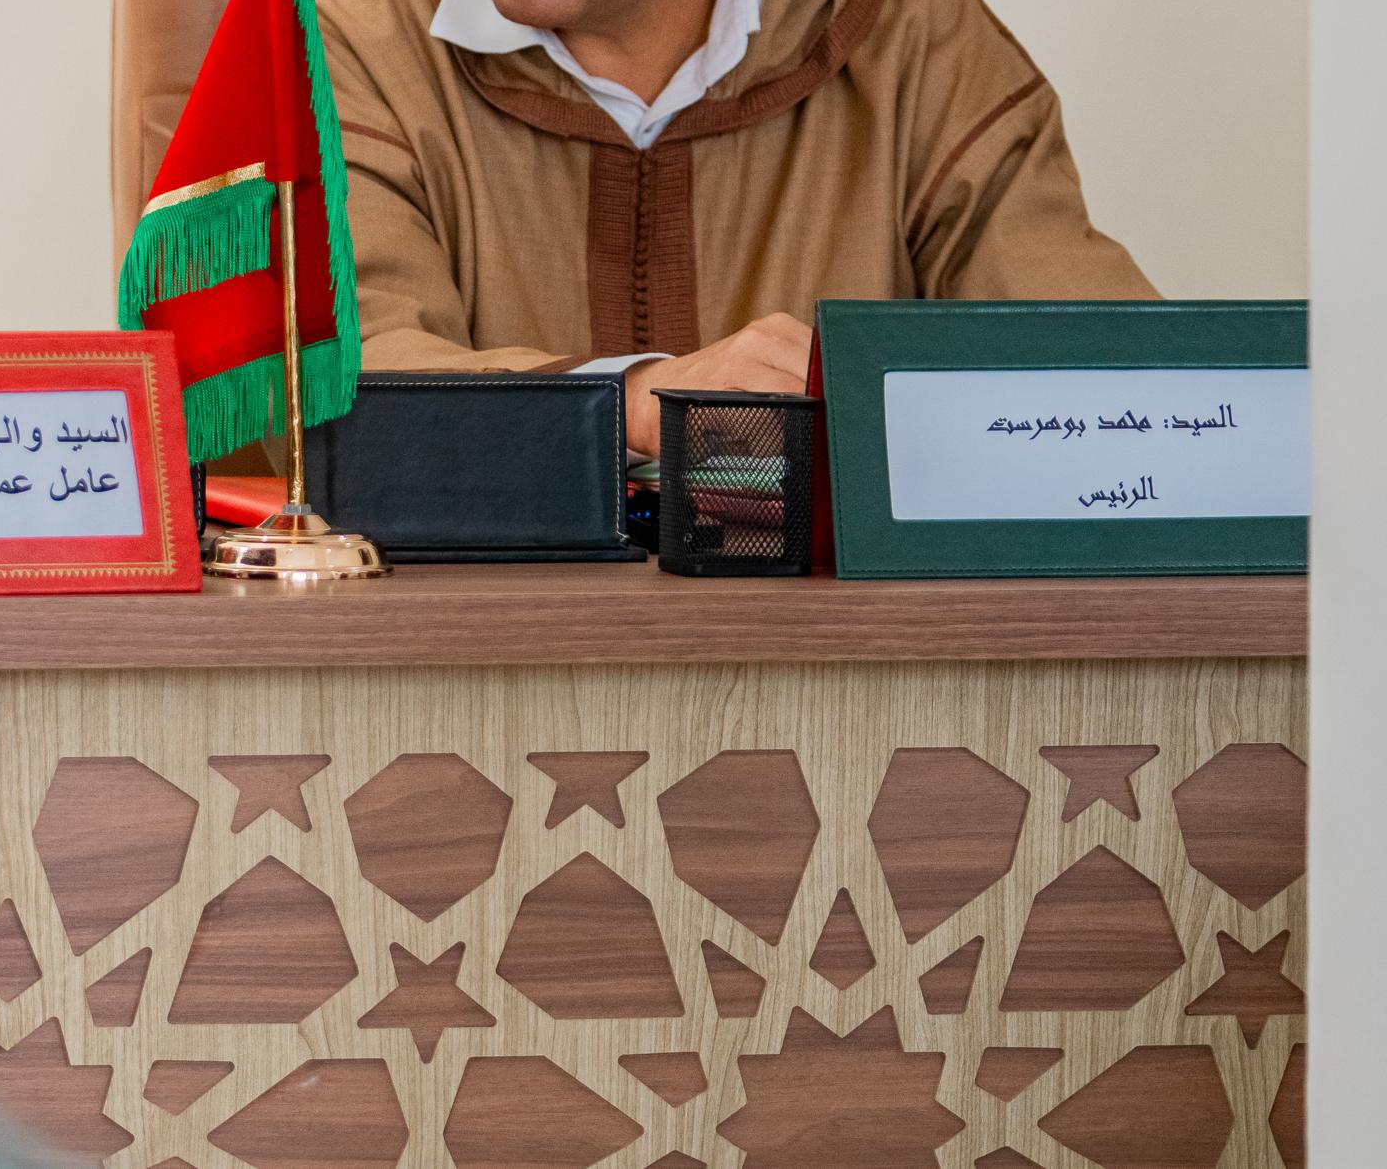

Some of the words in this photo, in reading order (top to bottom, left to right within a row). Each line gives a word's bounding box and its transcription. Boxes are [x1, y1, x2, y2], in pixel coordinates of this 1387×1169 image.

[56, 414, 131, 452] السيد
[1097, 409, 1153, 433] محمد
[1163, 403, 1238, 437] السيد:
[49, 465, 120, 502] عامل
[1077, 475, 1160, 510] الرئيس
